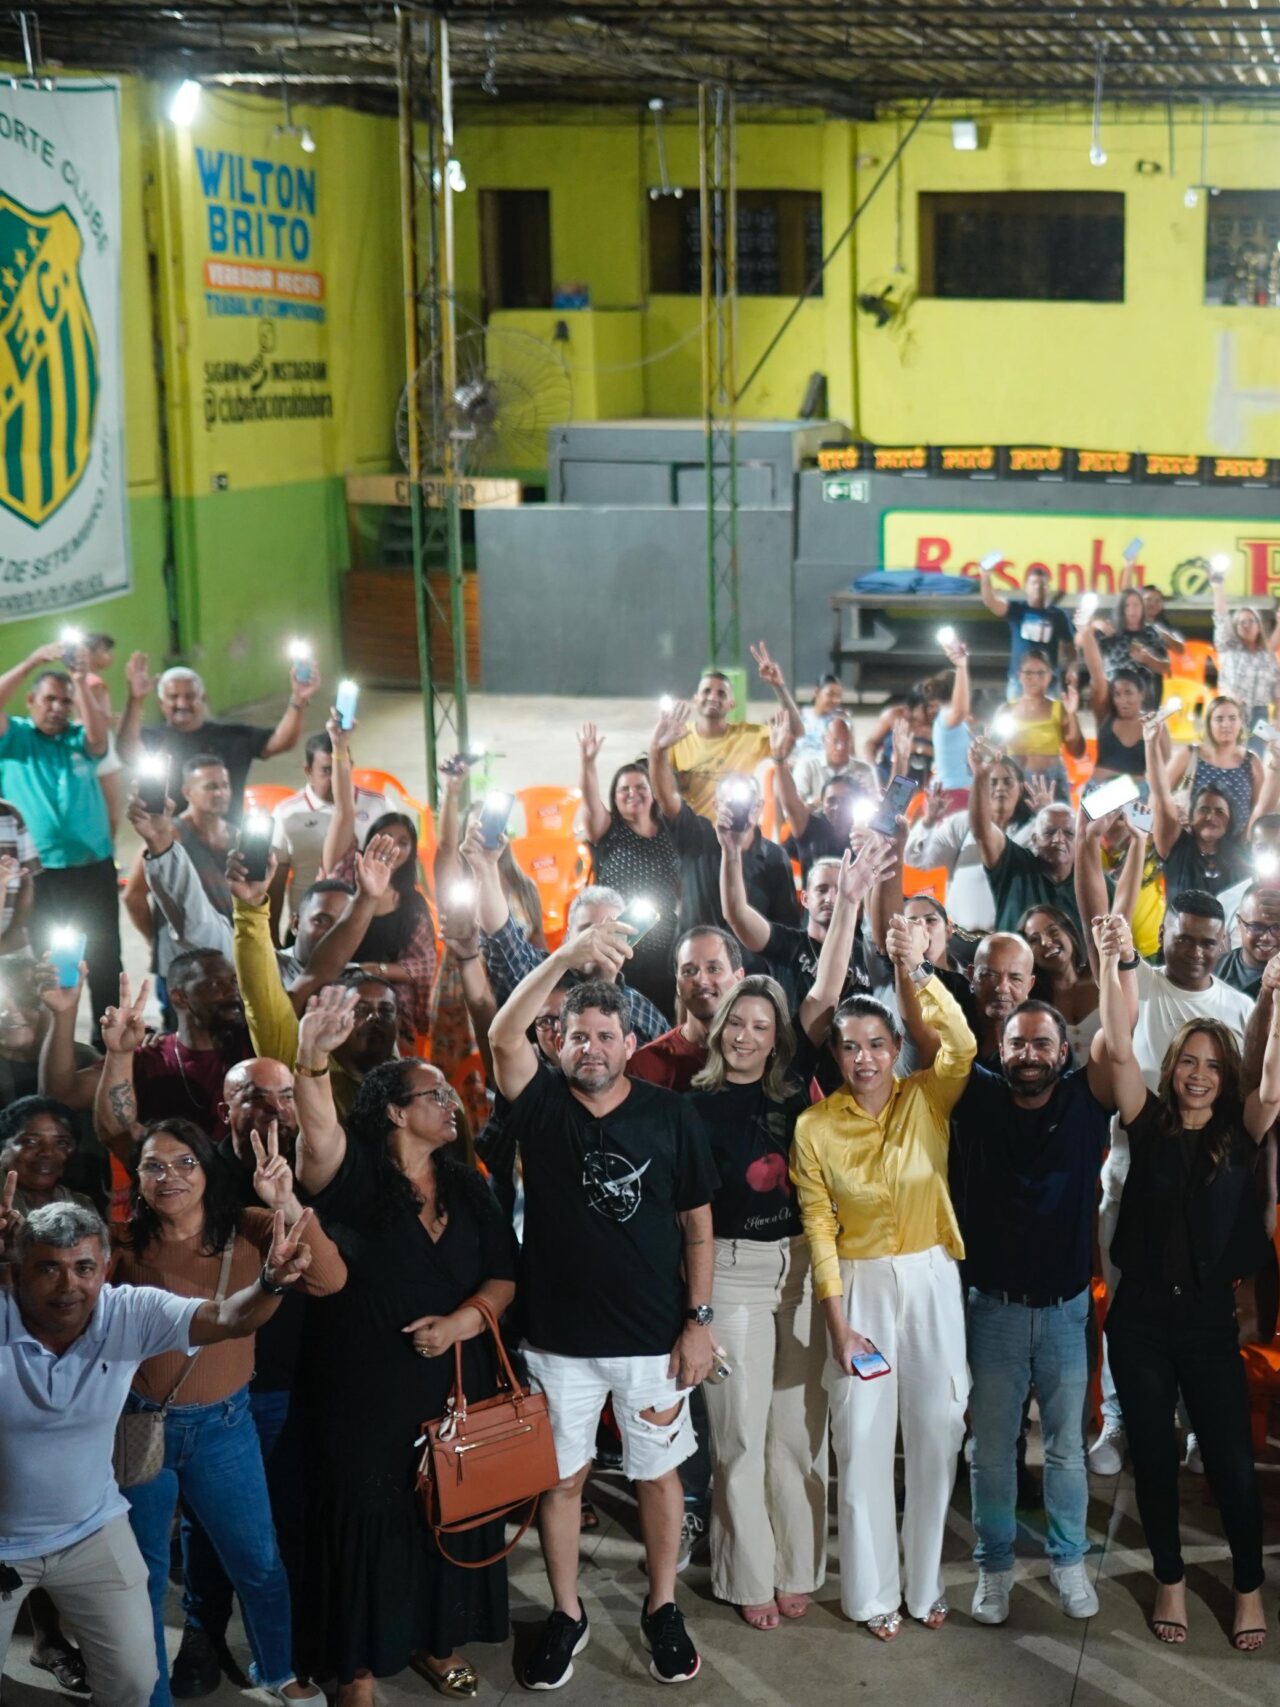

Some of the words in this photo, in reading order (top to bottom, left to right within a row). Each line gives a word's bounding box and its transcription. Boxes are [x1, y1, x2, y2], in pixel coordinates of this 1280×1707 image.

[61, 159, 109, 253] CLUBE
[195, 146, 316, 216] WILTON
[208, 204, 310, 262] BRITO
